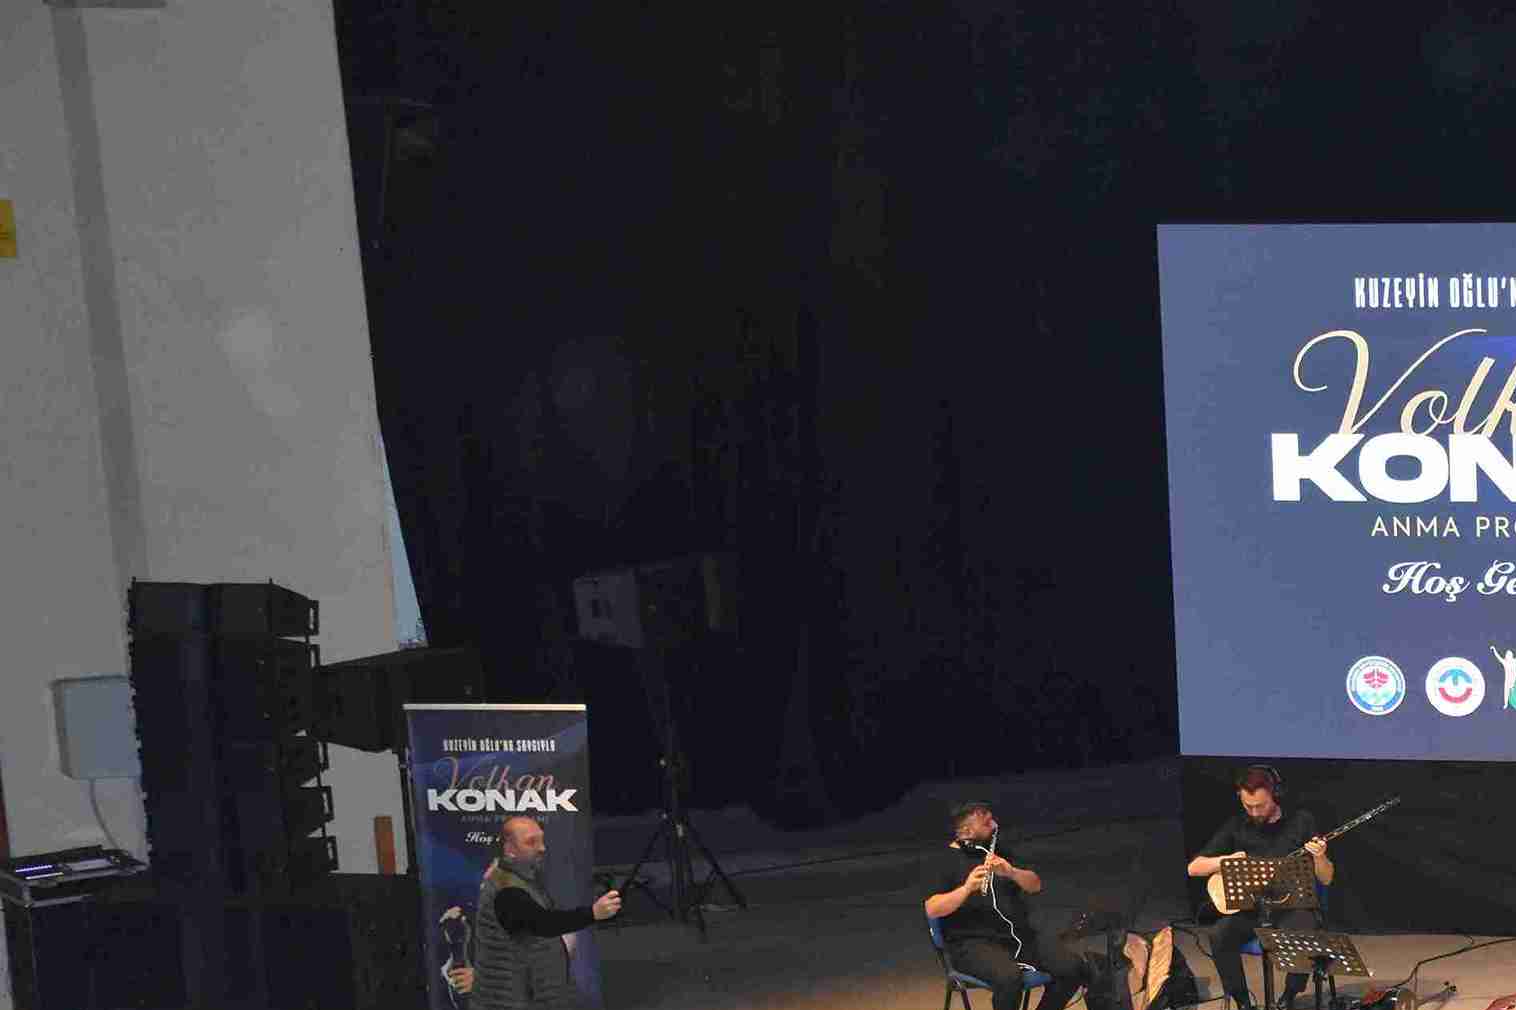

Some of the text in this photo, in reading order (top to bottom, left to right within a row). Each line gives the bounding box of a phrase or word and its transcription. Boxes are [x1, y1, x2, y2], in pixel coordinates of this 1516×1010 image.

[1353, 272, 1440, 308] KUZEYİN
[1371, 516, 1461, 538] ANMA
[1382, 560, 1471, 603] Hoş
[432, 756, 555, 791] Volkan
[427, 788, 579, 812] KONAK
